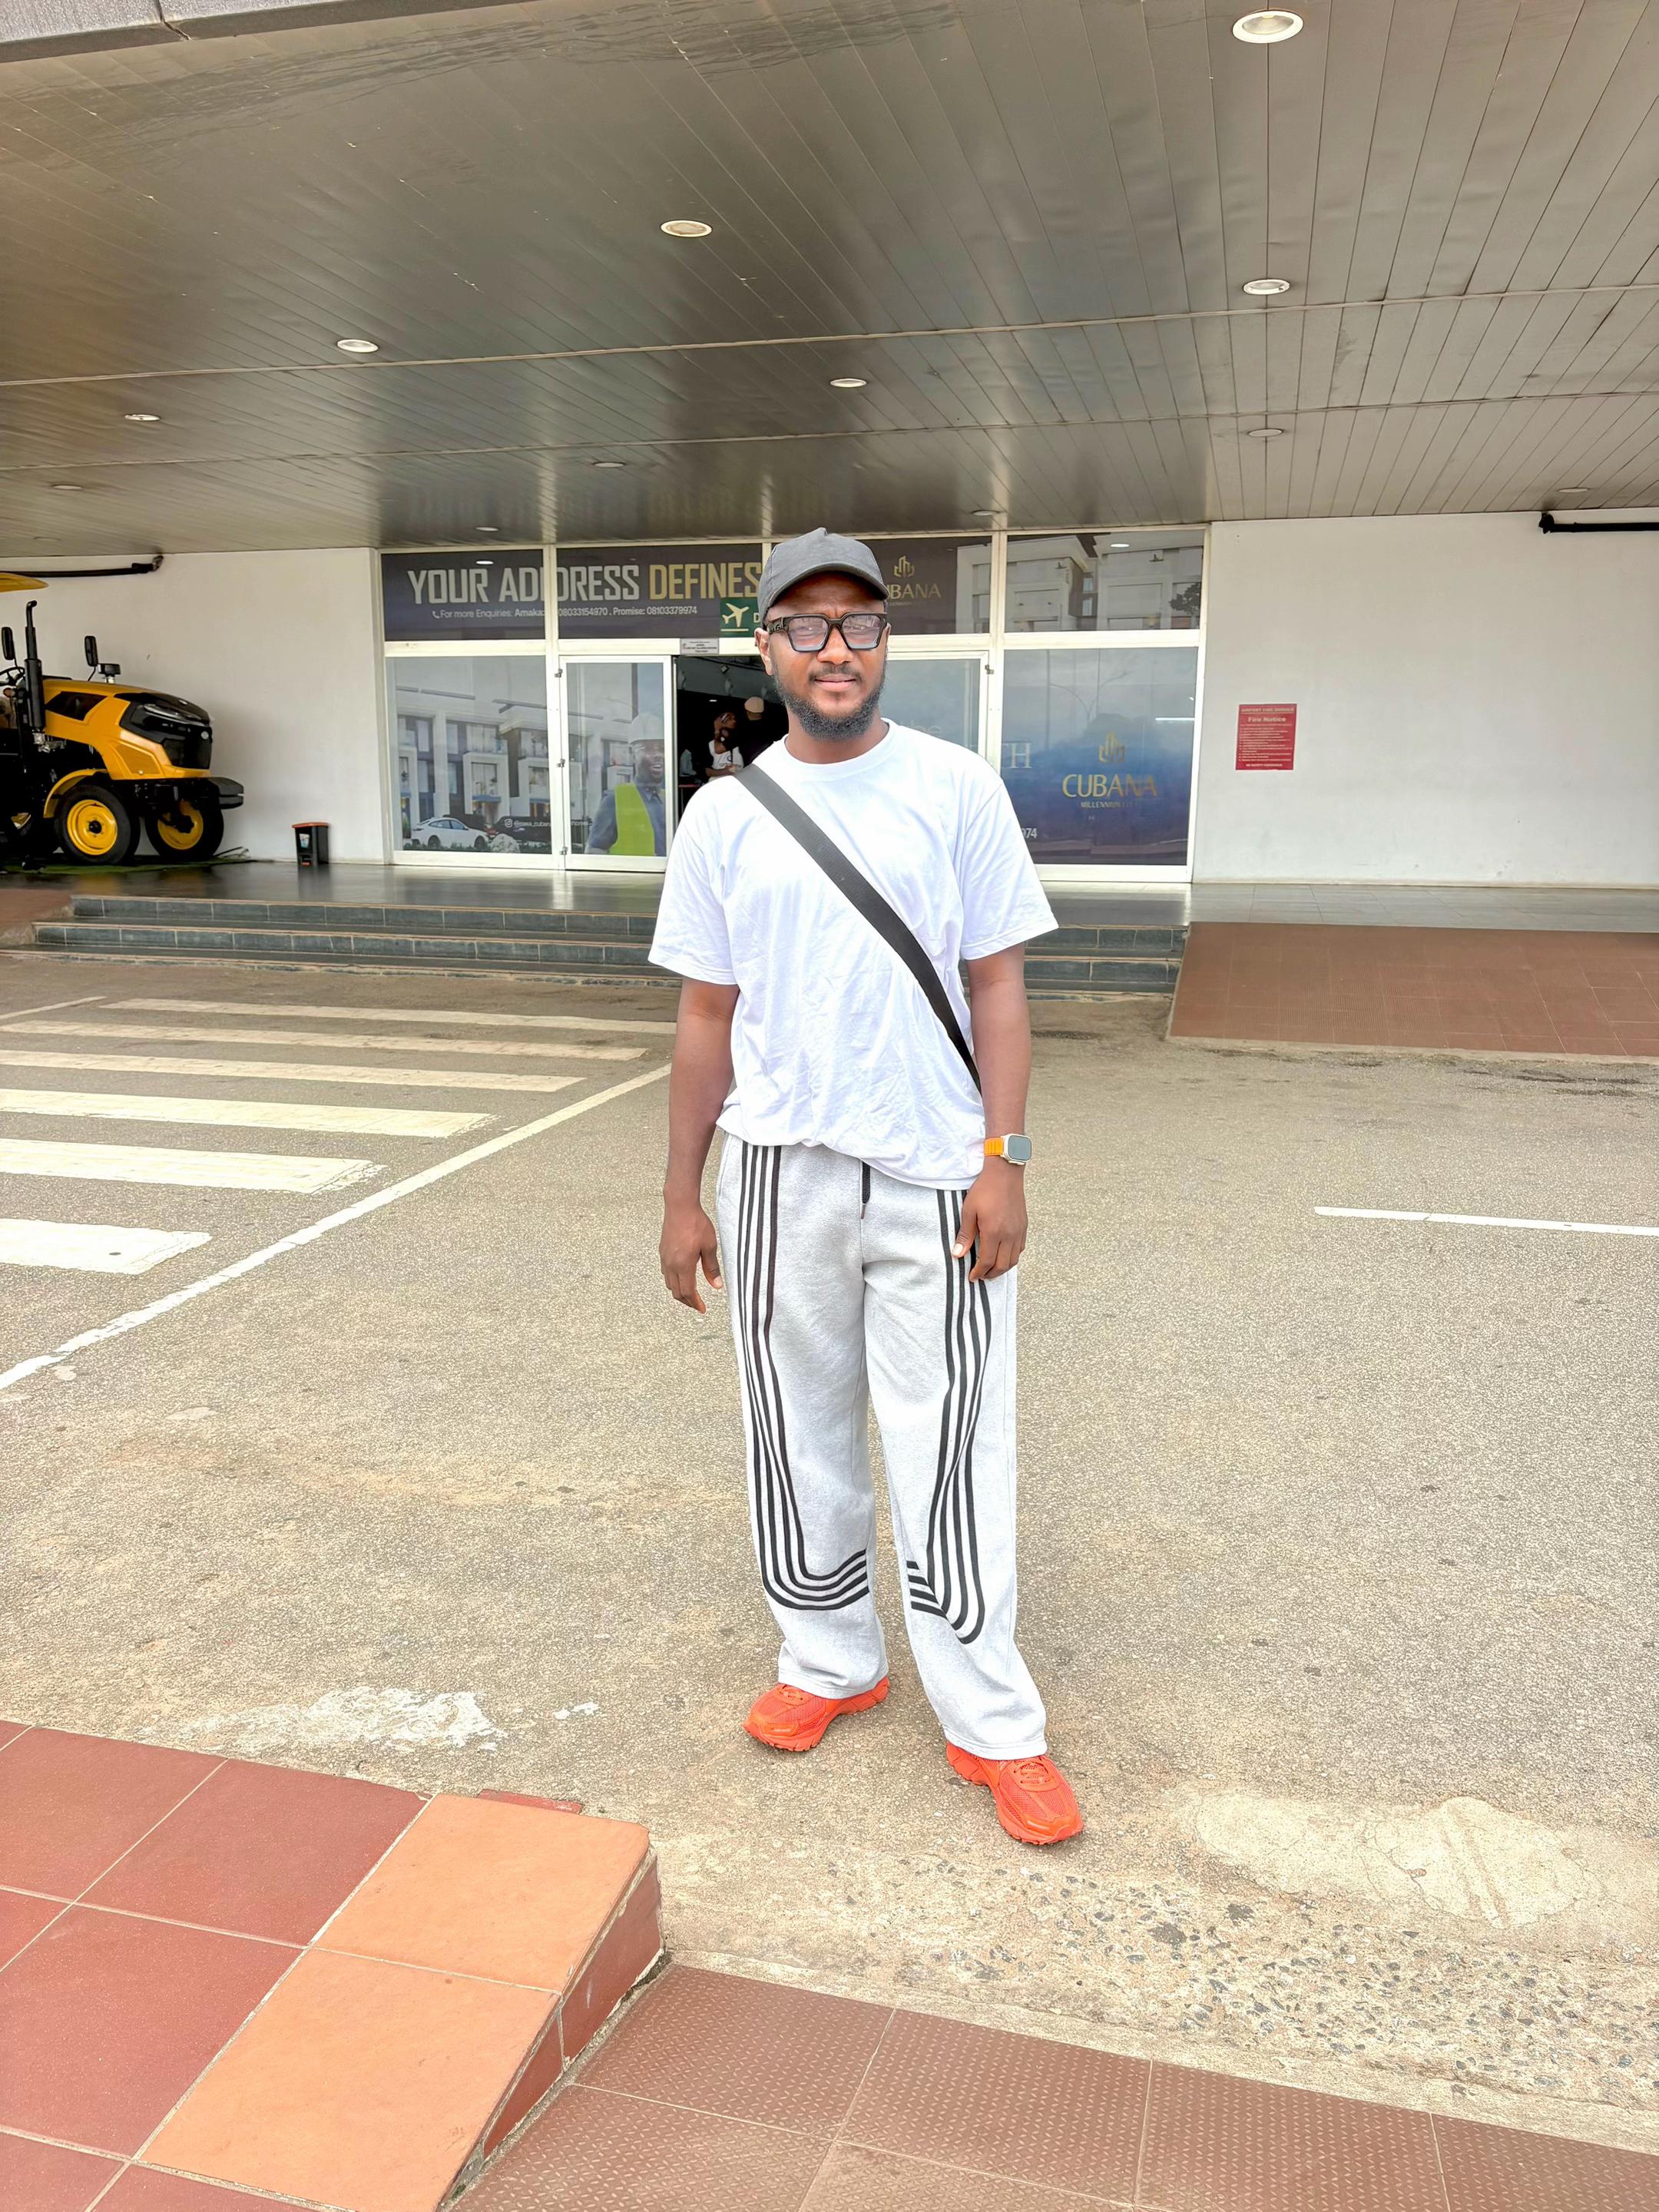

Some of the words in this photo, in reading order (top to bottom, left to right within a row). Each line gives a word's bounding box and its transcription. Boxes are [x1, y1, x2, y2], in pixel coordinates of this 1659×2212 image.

[407, 568, 489, 604] YOUR
[649, 562, 762, 600] DEFINES
[887, 583, 942, 599] BANA
[440, 609, 452, 618] For
[1061, 773, 1157, 798] CUBANA
